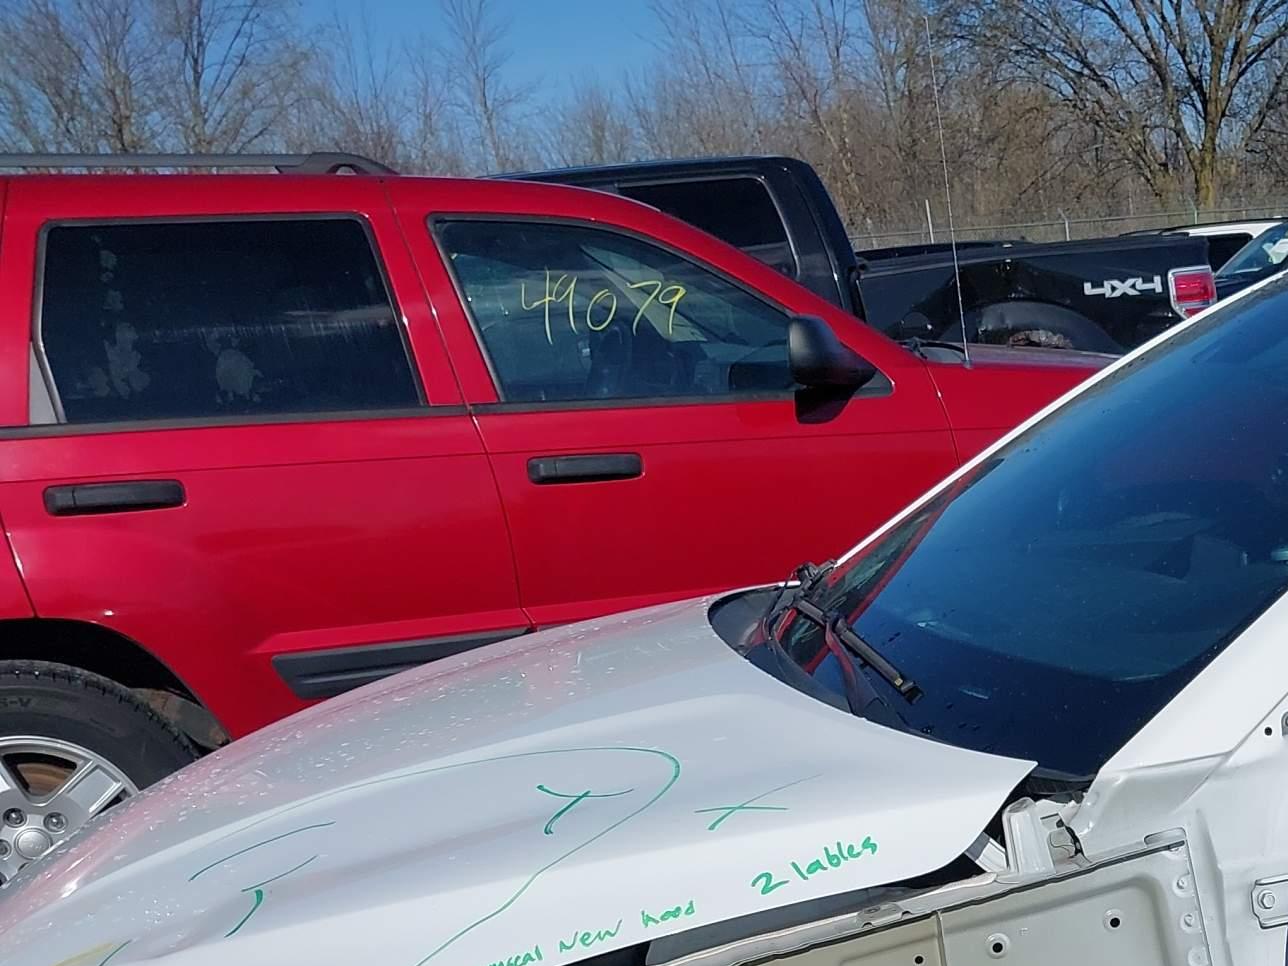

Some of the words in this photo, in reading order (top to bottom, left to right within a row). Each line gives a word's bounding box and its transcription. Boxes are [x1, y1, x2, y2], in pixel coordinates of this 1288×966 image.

[521, 266, 687, 345] 49079
[751, 871, 789, 897] 2
[791, 834, 878, 884] lables
[558, 919, 623, 953] New
[640, 899, 697, 930] hood
